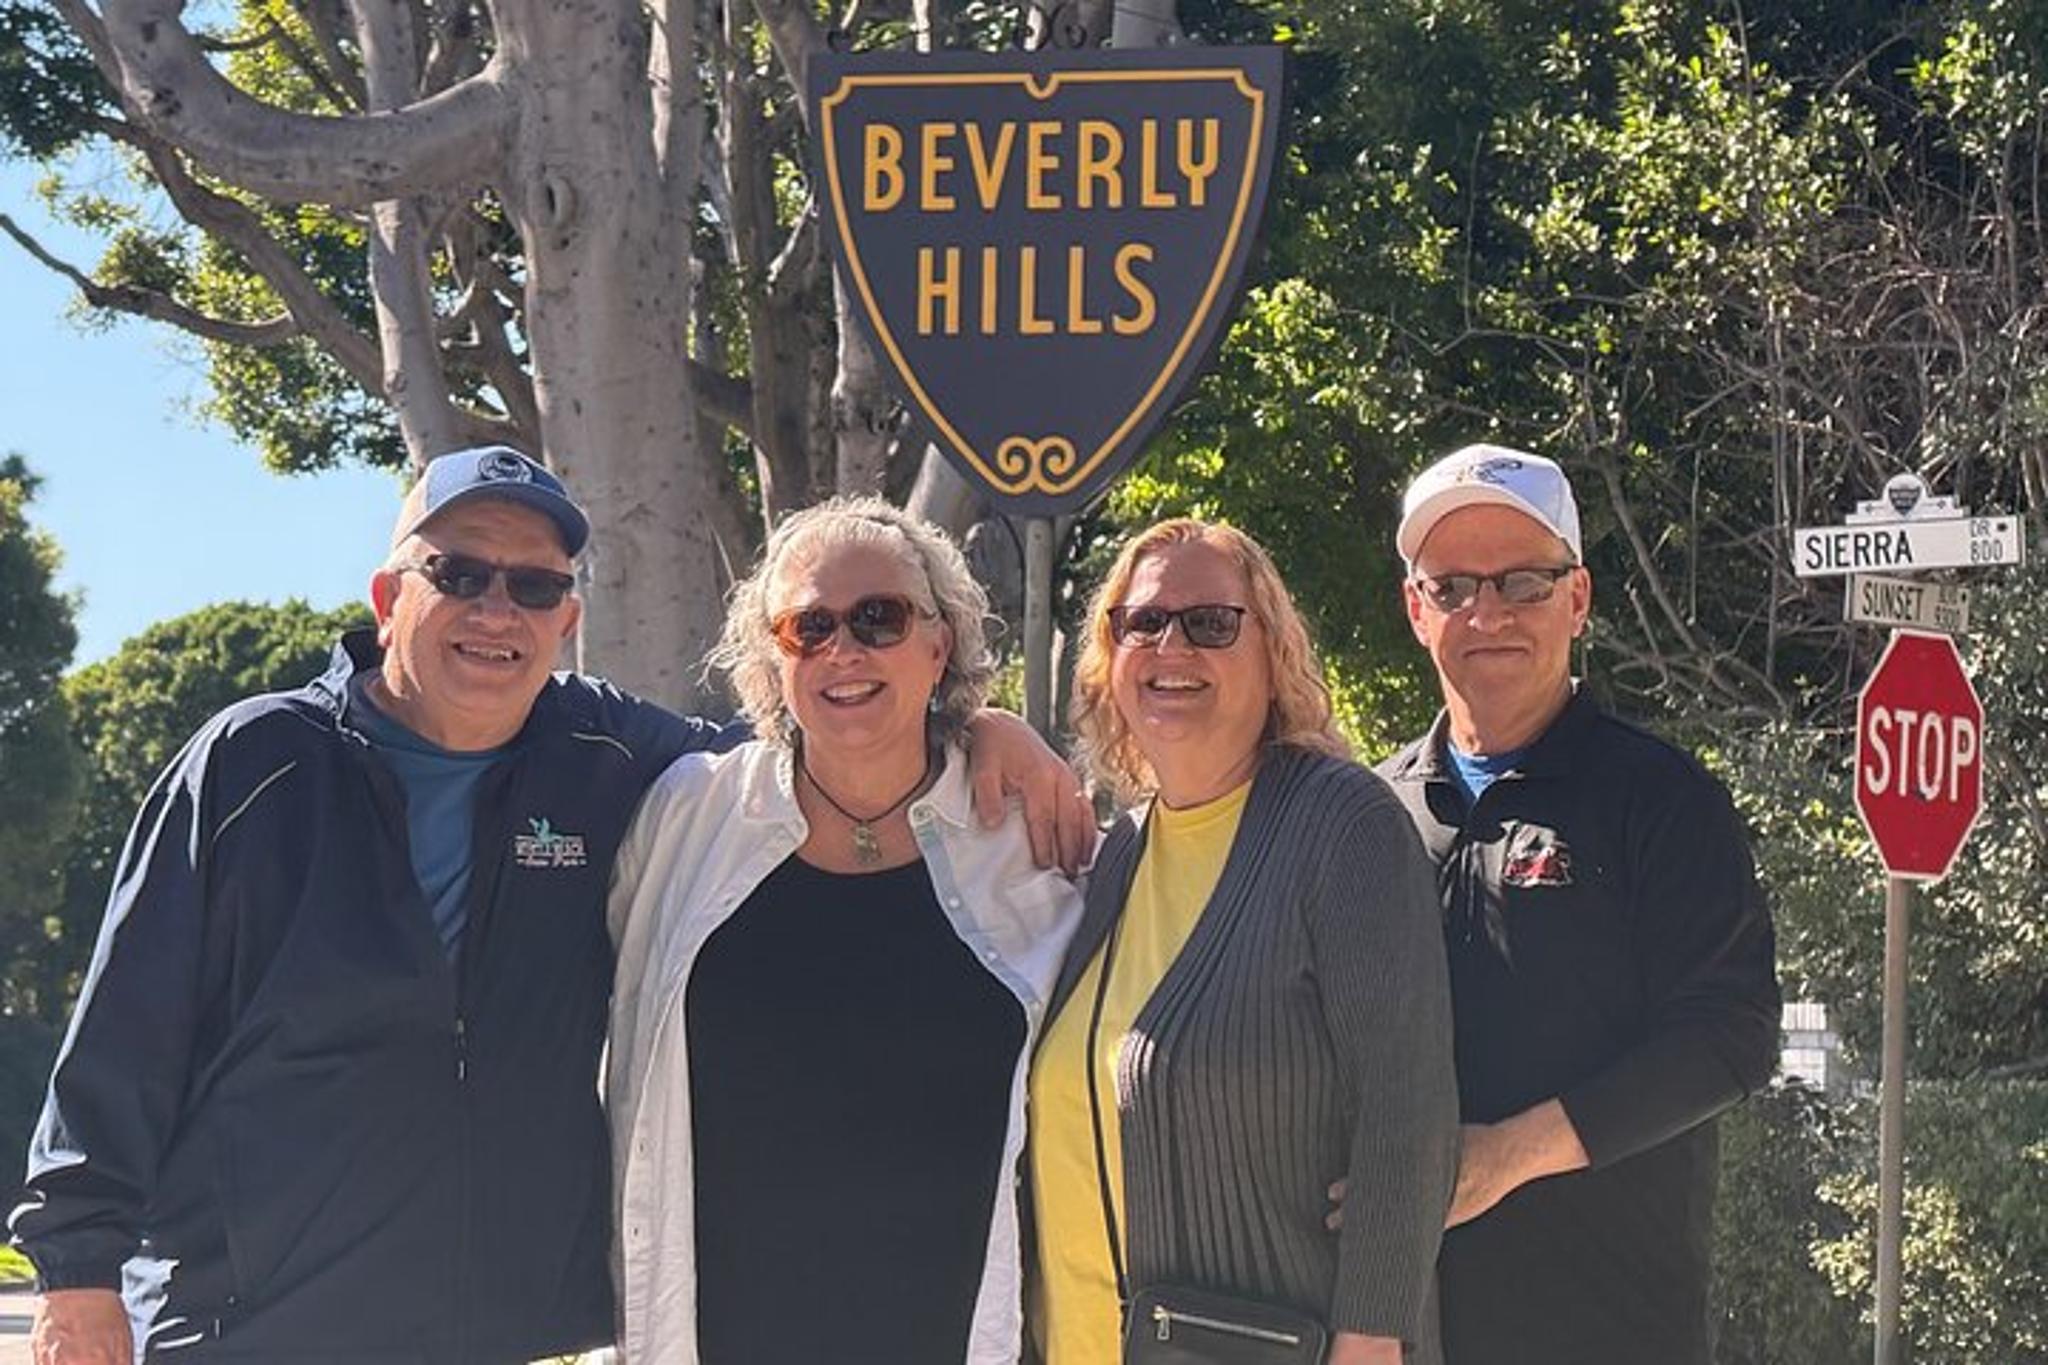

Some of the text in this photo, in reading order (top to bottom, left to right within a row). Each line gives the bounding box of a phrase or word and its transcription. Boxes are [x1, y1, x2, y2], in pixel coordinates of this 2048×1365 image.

[863, 118, 1219, 212] BEVERLY
[918, 243, 1156, 335] HILLS
[1805, 530, 1913, 570] SIERRA
[1970, 519, 1991, 538] DR
[1861, 580, 1924, 623] SUNSET
[1865, 706, 1976, 803] STOP
